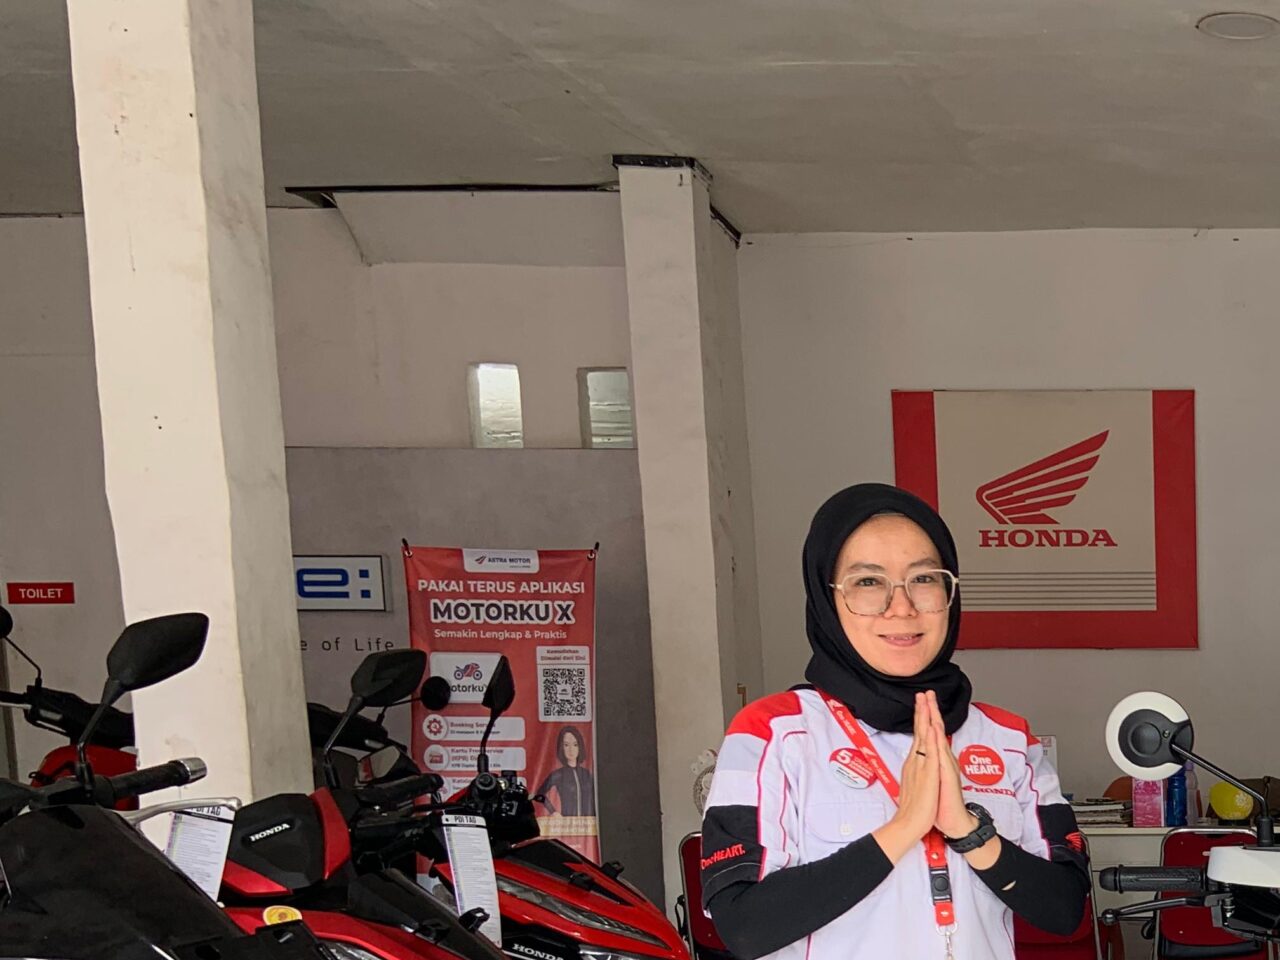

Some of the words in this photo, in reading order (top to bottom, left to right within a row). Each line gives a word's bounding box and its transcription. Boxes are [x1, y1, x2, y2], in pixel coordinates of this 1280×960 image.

[979, 529, 1118, 547] HONDA
[19, 588, 63, 599] TOILET
[417, 579, 464, 592] PAKAI
[467, 580, 516, 593] TERUS
[519, 581, 585, 594] APLIKASI
[432, 601, 550, 622] MOTORKU
[556, 602, 574, 623] X
[434, 629, 478, 639] Semakin
[480, 630, 523, 640] Lengkap
[525, 631, 532, 639] &
[534, 630, 567, 639] Praktis
[321, 638, 340, 651] of
[354, 638, 394, 652] Life
[836, 749, 853, 765] 5
[969, 754, 992, 765] One
[465, 816, 477, 824] TAG
[249, 822, 291, 842] HONDA
